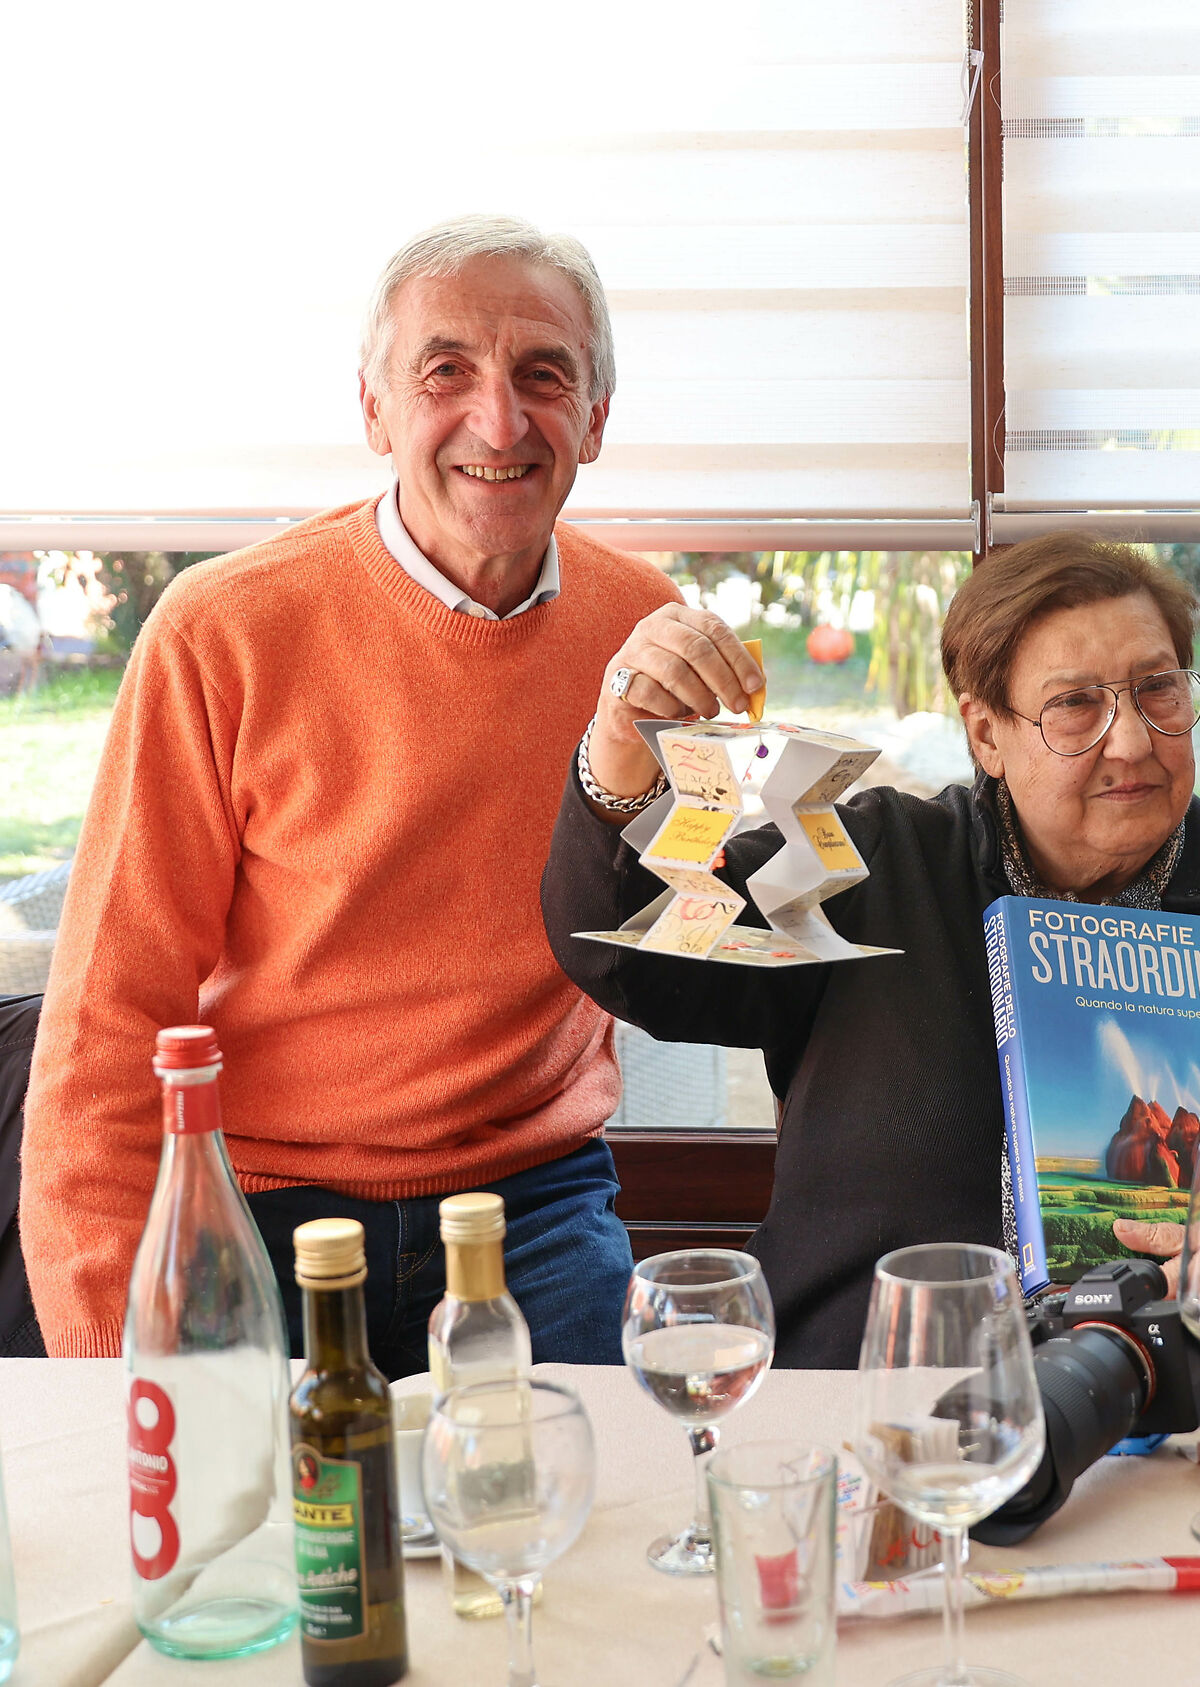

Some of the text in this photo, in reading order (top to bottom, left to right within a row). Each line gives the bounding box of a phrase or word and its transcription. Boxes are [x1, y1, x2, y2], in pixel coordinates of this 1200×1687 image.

[1028, 909, 1195, 946] FOTOGRAFIE
[984, 915, 1009, 1050] STRAORDINARIO
[995, 911, 1016, 1039] FOTOGRAFIE DELLO
[1075, 996, 1123, 1011] Quando
[1125, 1001, 1136, 1012] la
[1138, 1004, 1175, 1017] natura
[1004, 1054, 1012, 1092] Quando
[1009, 1100, 1017, 1132] natura
[1012, 1132, 1020, 1163] supera
[1017, 1174, 1025, 1203] stessa
[1074, 1294, 1113, 1306] SONY
